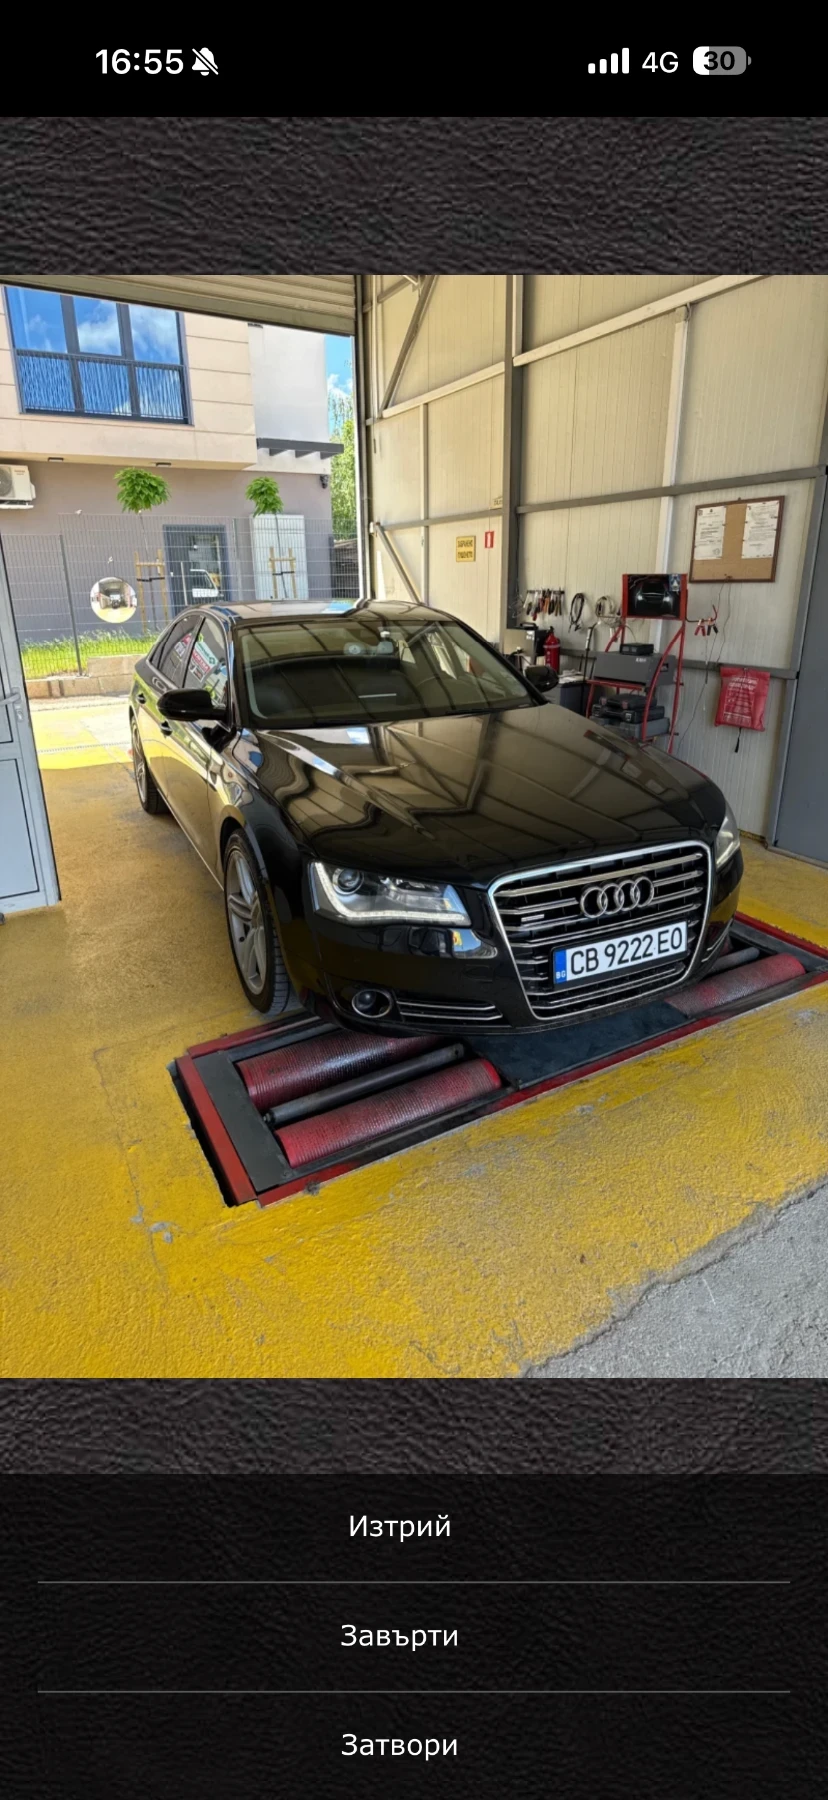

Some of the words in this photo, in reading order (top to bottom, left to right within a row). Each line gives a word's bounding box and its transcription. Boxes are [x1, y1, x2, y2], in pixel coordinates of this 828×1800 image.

[570, 947, 599, 975] CB
[604, 934, 654, 968] 9222
[556, 971, 566, 979] BG
